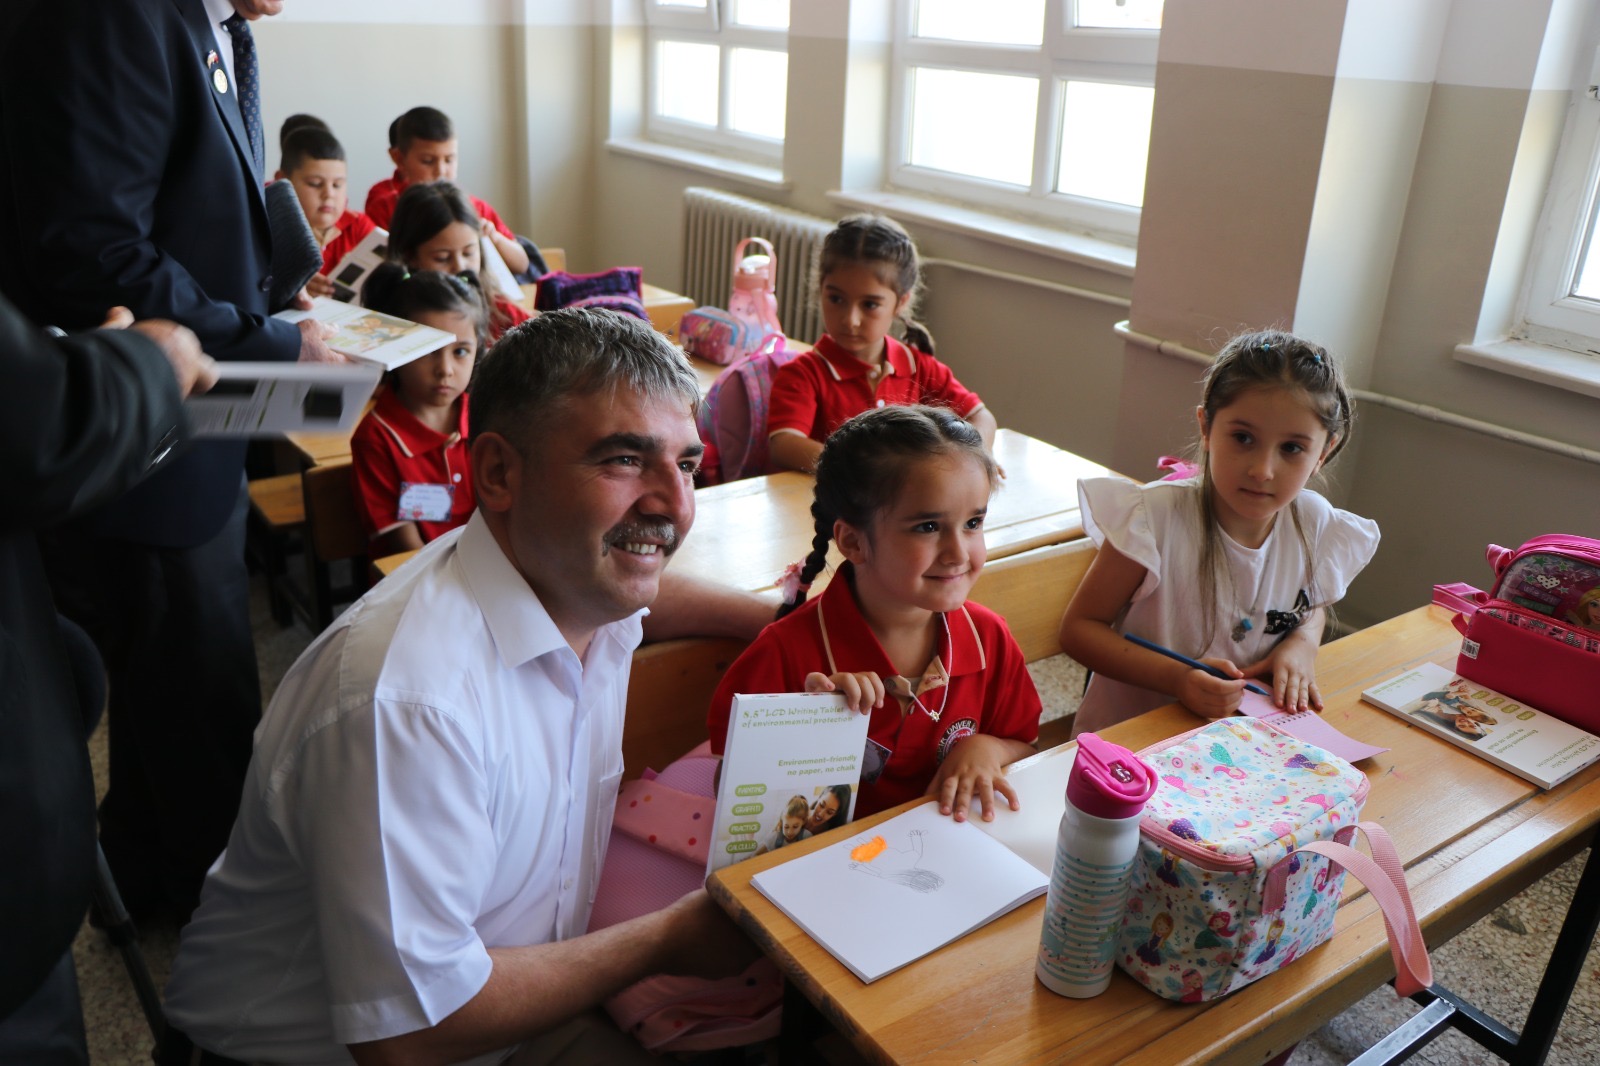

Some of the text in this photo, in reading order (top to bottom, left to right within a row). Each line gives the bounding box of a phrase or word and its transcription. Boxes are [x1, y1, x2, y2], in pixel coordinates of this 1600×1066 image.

[766, 708, 786, 717] LCD
[788, 706, 818, 716] Writing
[742, 716, 853, 728] of environmental protection
[837, 764, 856, 772] chalk
